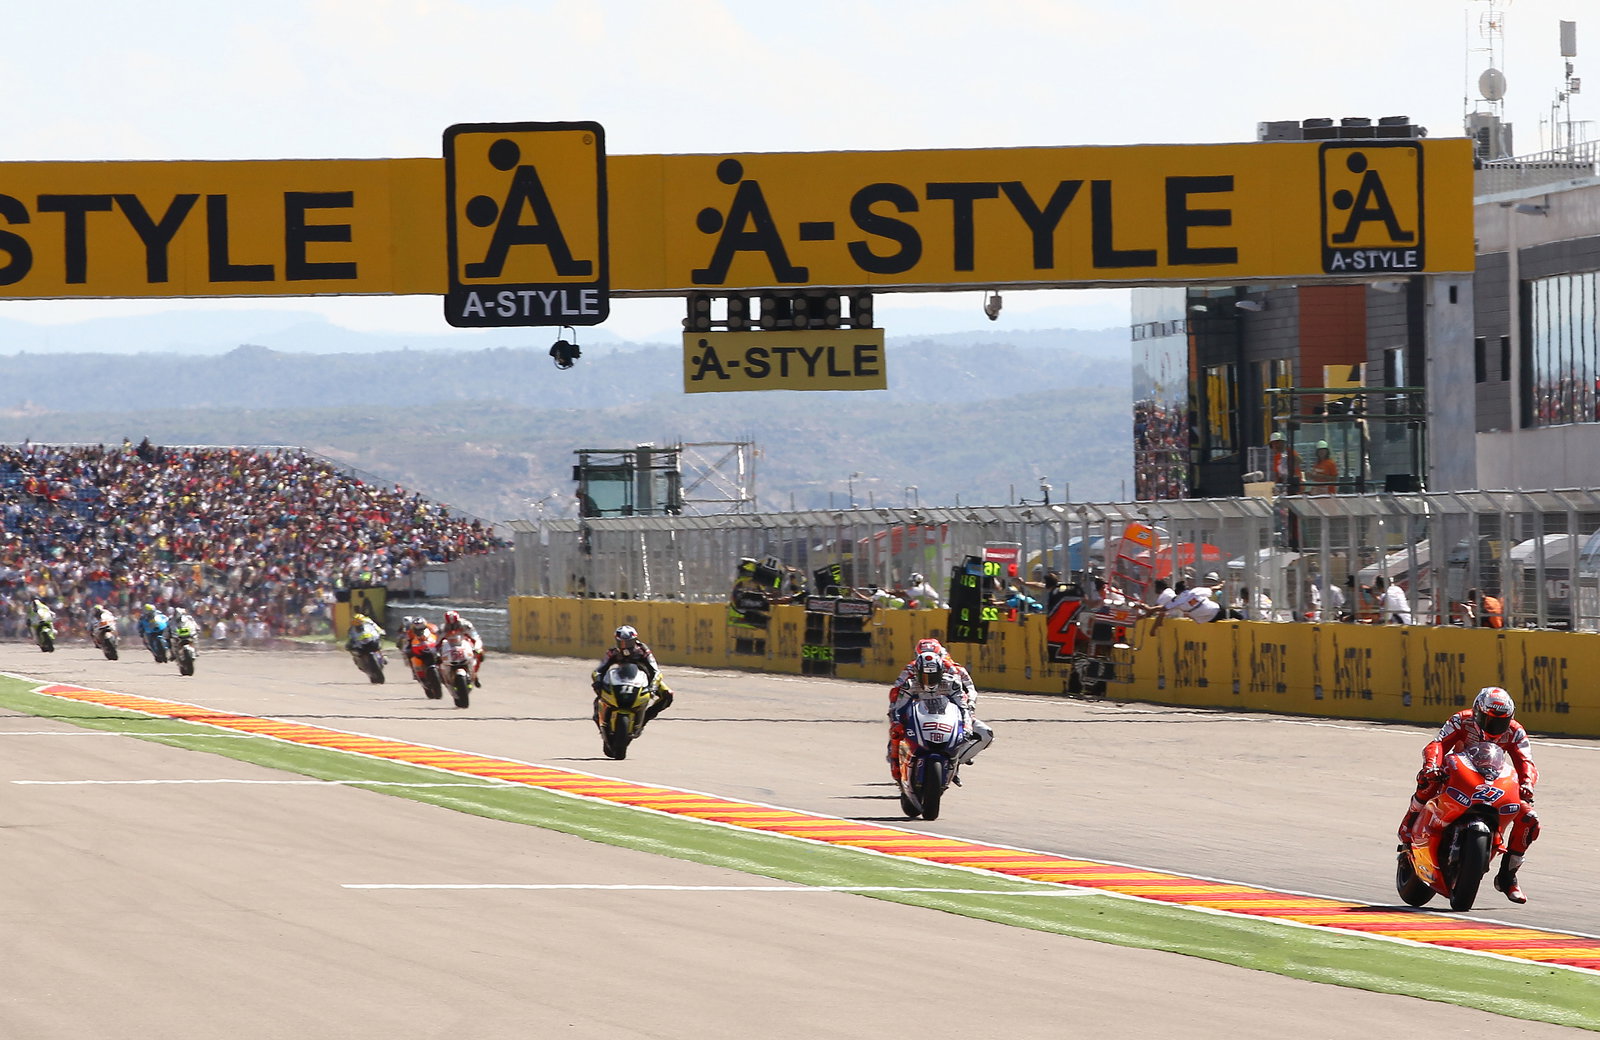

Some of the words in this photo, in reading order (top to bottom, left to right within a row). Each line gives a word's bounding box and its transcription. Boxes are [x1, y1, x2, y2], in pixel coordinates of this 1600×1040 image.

[690, 168, 1239, 286] A-STYLE
[1331, 250, 1418, 270] A-STYLE
[461, 289, 600, 317] A-STYLE
[691, 343, 880, 380] A-STYLE
[1522, 646, 1569, 713] A-STYLE
[1456, 793, 1470, 805] TIM
